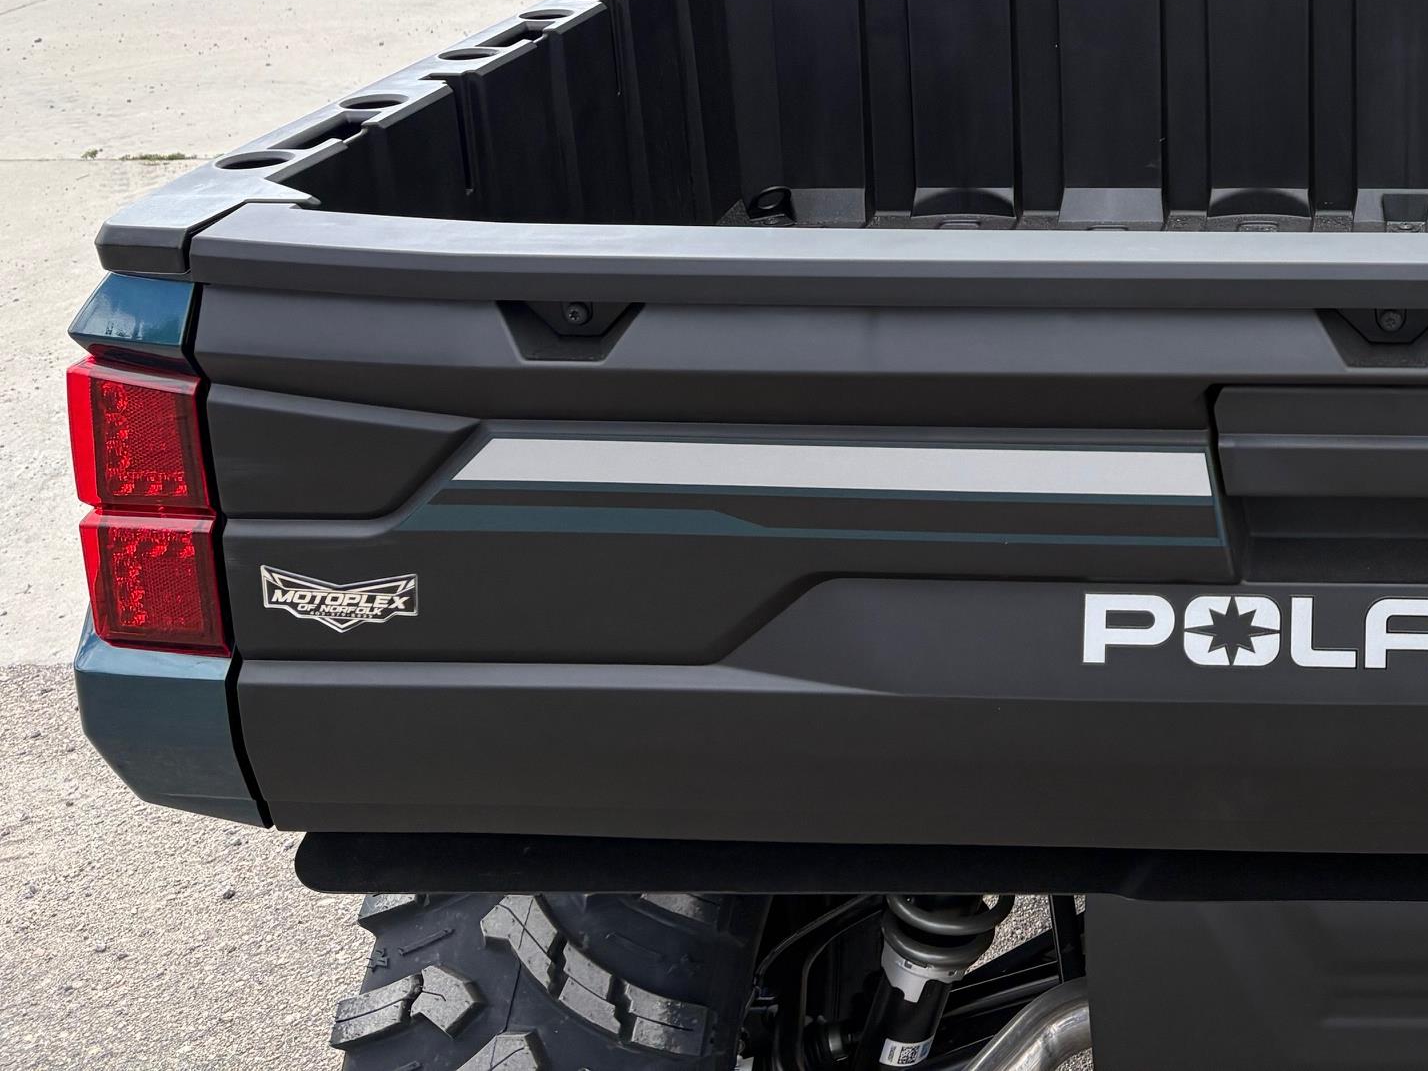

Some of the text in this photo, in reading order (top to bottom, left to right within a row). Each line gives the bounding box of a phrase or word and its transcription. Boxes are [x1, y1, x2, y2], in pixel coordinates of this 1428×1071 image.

[271, 589, 411, 610] MOTOPLEX
[297, 603, 384, 616] OF NORFOLK
